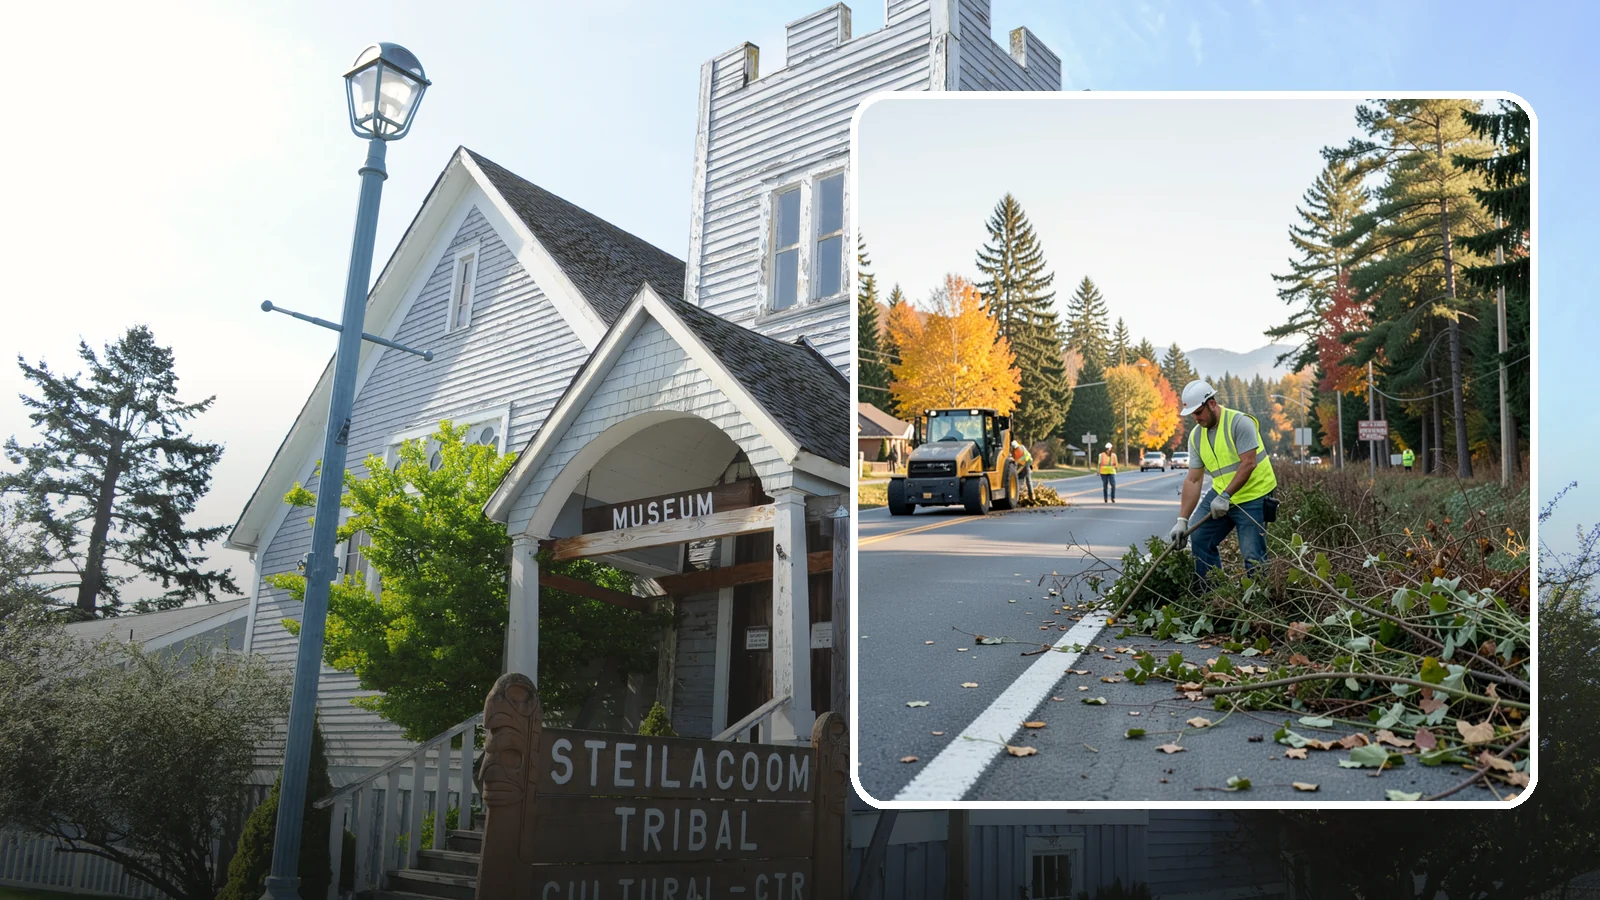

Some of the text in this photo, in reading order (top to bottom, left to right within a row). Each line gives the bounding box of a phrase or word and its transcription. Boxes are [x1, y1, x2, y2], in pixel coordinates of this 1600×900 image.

[612, 491, 713, 531] MUSEUM
[550, 738, 810, 792] STEILACOOM
[614, 806, 758, 852] TRIBAL
